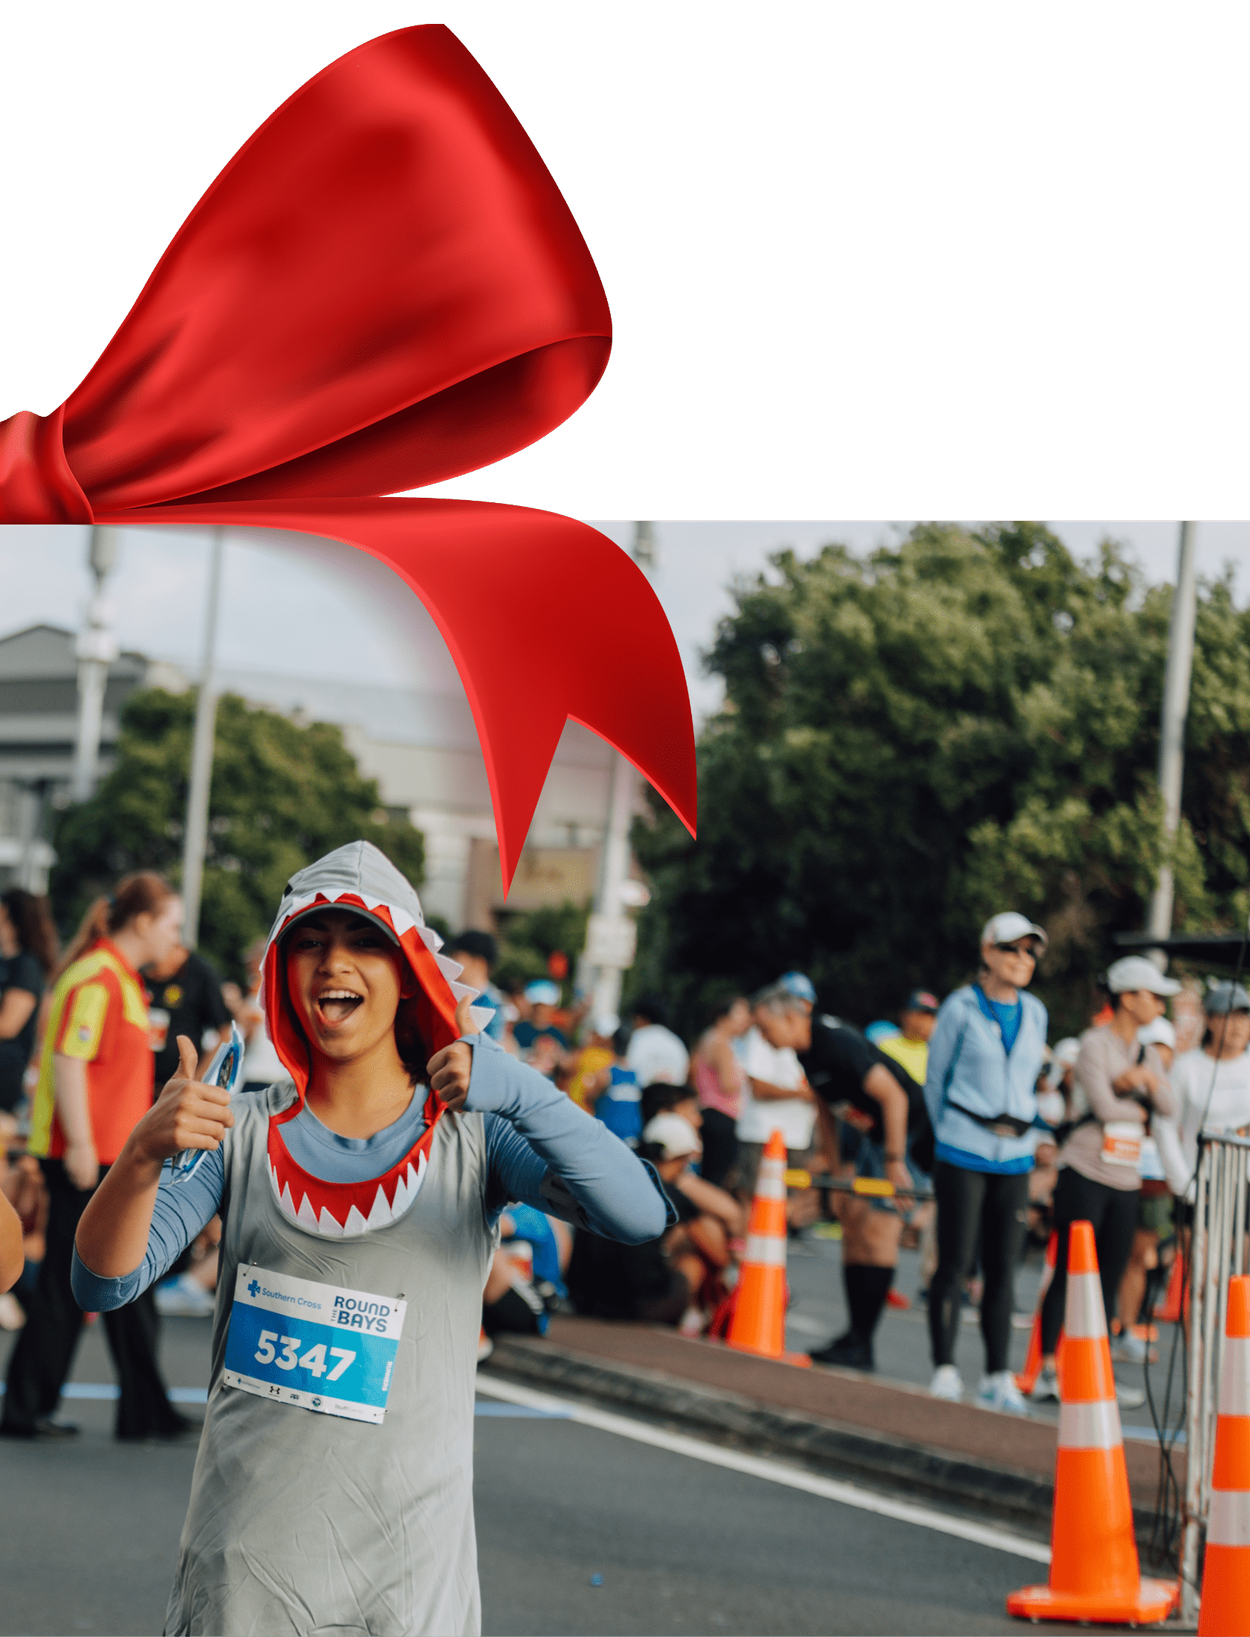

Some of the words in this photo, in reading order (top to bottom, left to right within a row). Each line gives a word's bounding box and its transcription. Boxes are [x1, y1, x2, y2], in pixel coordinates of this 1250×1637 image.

[262, 1287, 296, 1304] Southern
[297, 1297, 322, 1310] Cross
[334, 1295, 390, 1317] ROUND
[337, 1310, 388, 1333] BAYS
[253, 1329, 357, 1382] 5347
